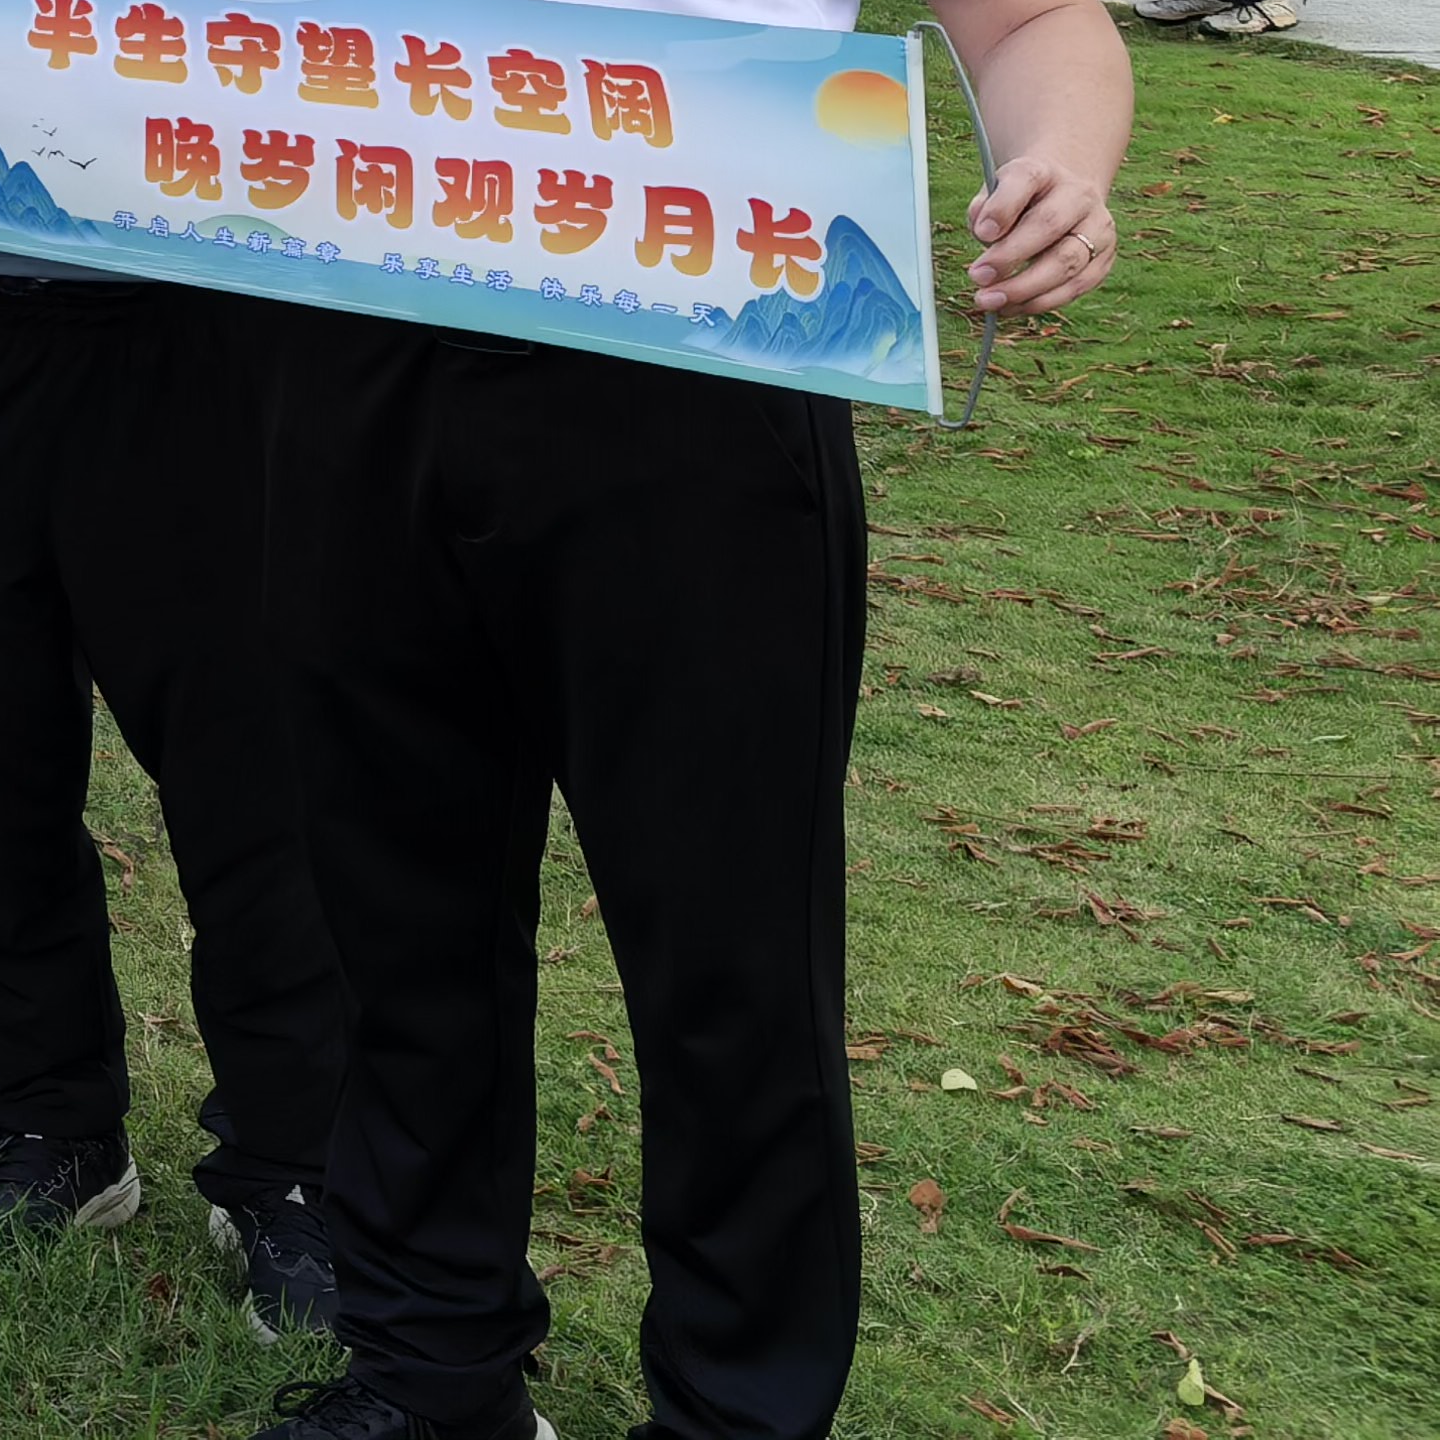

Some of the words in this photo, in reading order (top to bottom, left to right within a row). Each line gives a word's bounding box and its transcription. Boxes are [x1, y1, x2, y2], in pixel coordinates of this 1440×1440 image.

[114, 211, 341, 264] 开启人生新篇章
[143, 117, 827, 298] 晚岁闲观岁月长
